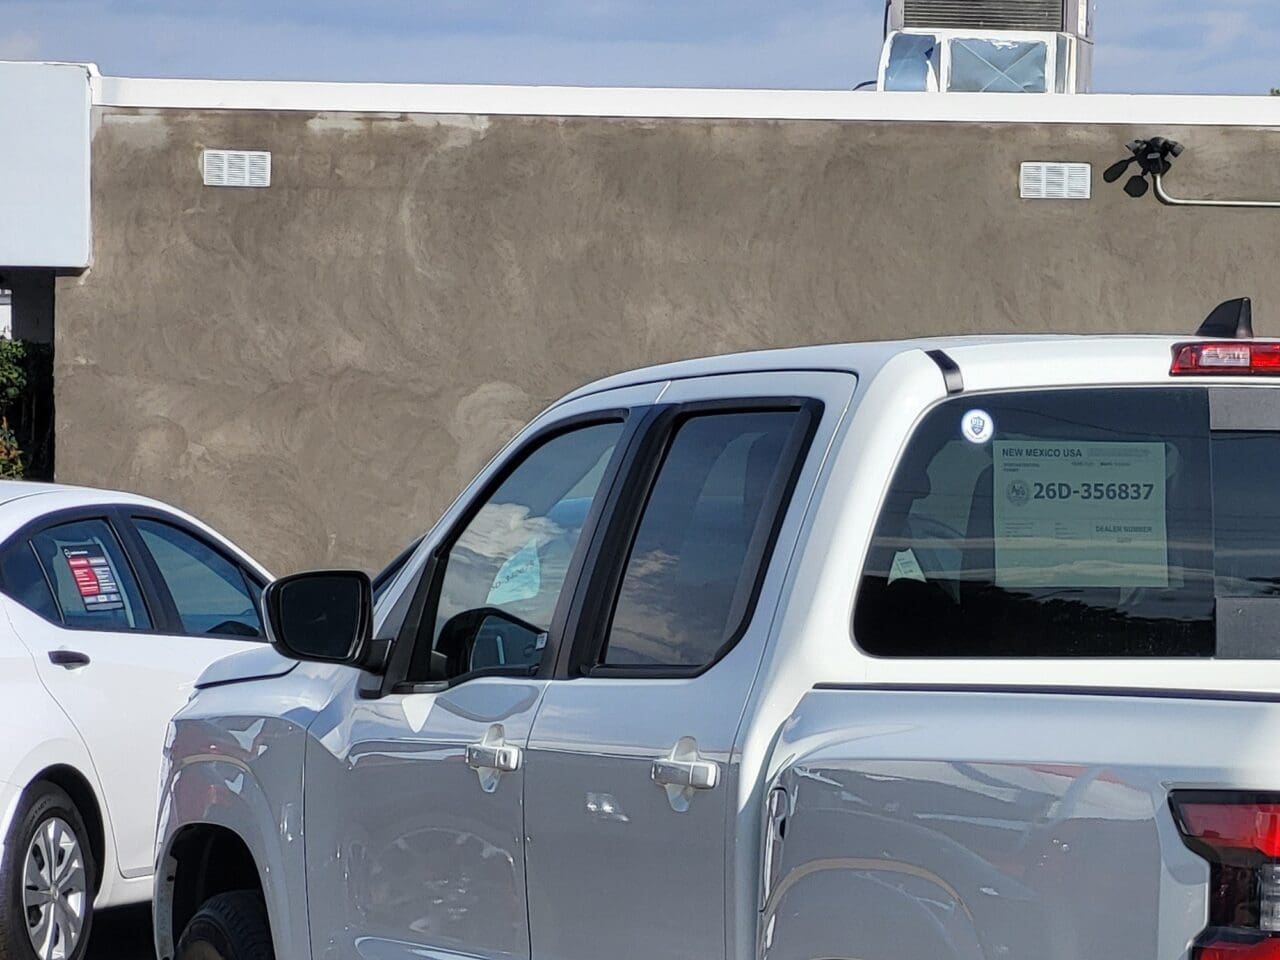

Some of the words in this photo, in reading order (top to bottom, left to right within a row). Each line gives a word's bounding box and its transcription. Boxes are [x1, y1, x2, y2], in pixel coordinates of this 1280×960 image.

[1002, 448, 1023, 457] NEW
[1025, 448, 1060, 457] MEXICO
[1063, 448, 1082, 457] USA
[1033, 483, 1154, 500] 26D-356837
[1095, 525, 1121, 533] DEALER
[1123, 525, 1152, 533] NUMBER
